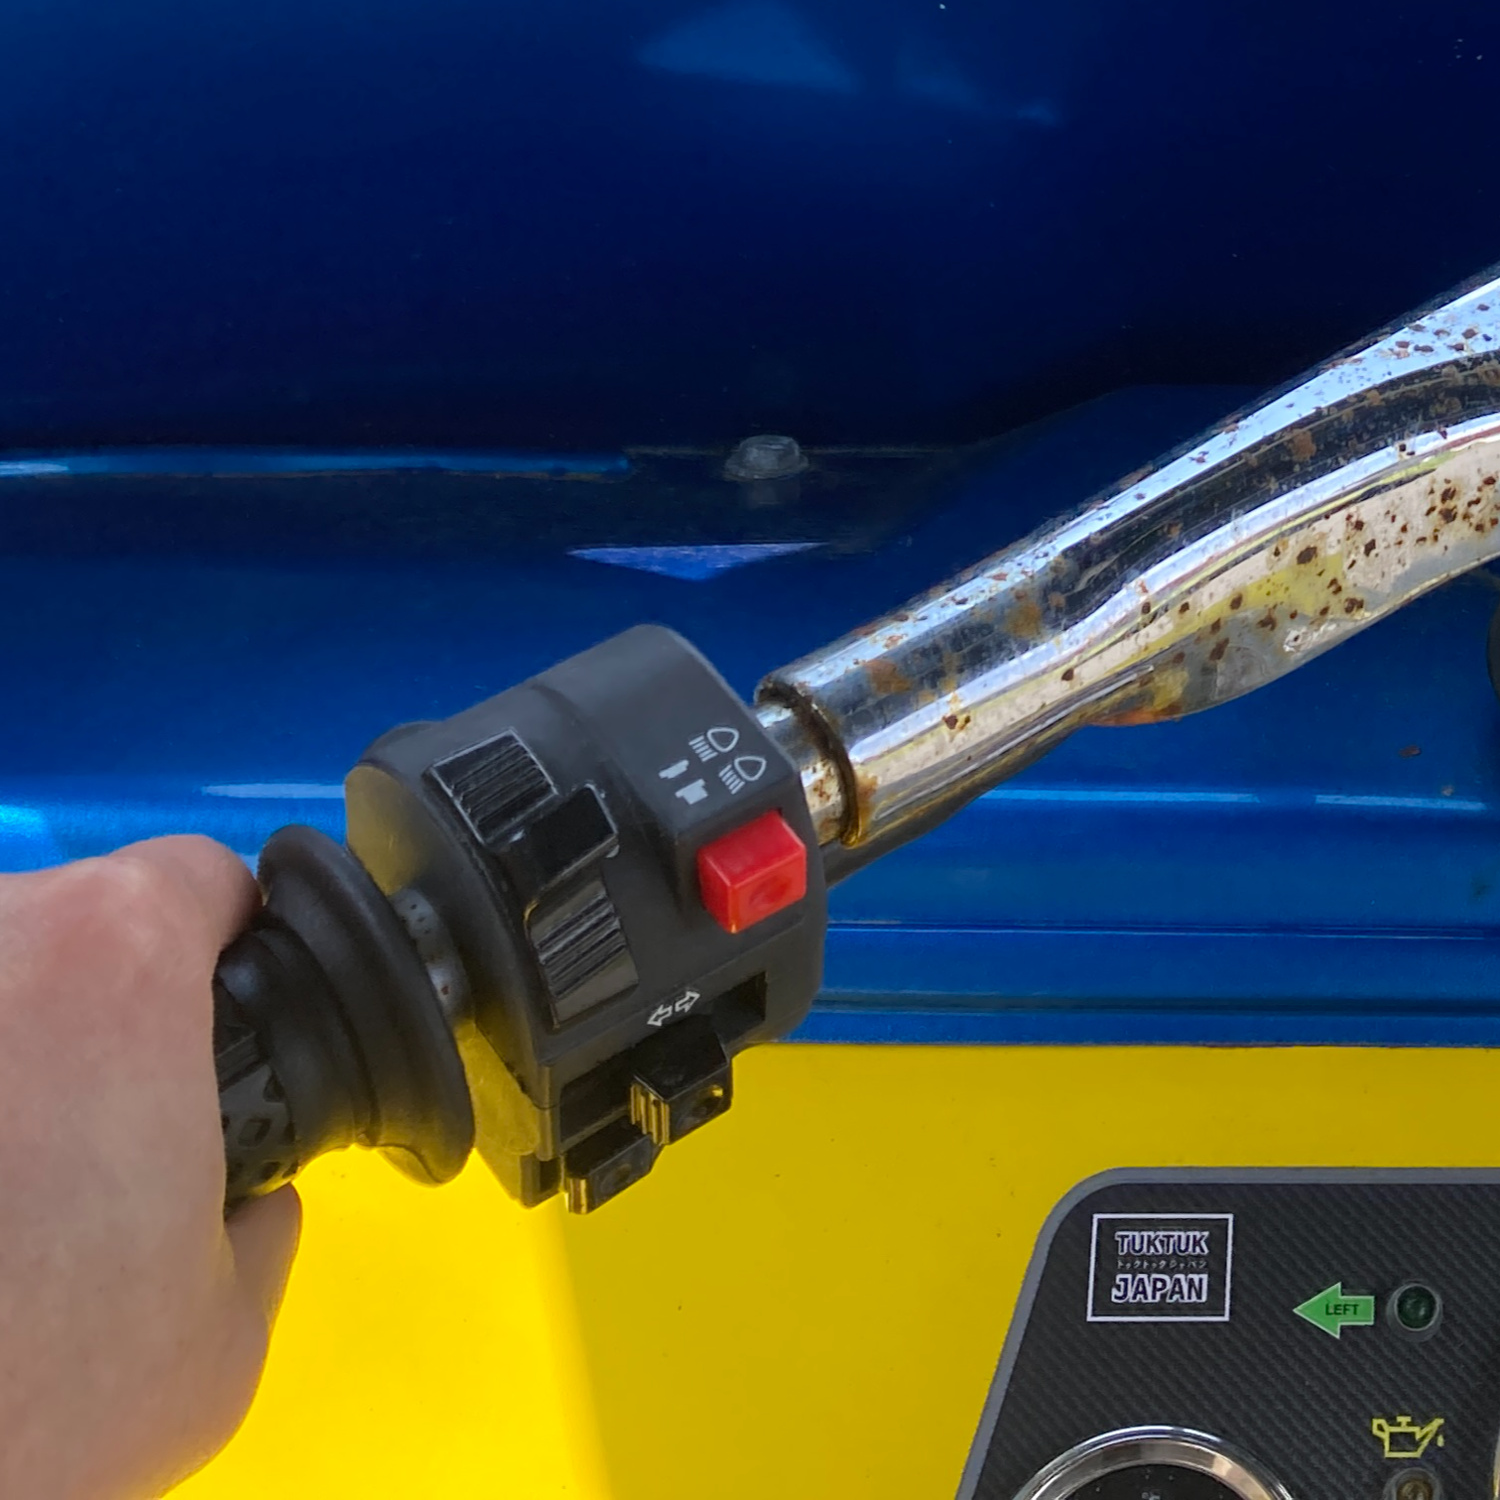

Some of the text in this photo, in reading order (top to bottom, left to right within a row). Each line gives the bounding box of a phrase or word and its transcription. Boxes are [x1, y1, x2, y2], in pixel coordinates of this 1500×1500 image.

[1115, 1231, 1210, 1255] TUKTUK
[1111, 1273, 1208, 1303] JAPAN
[1325, 1304, 1359, 1316] LEFT
